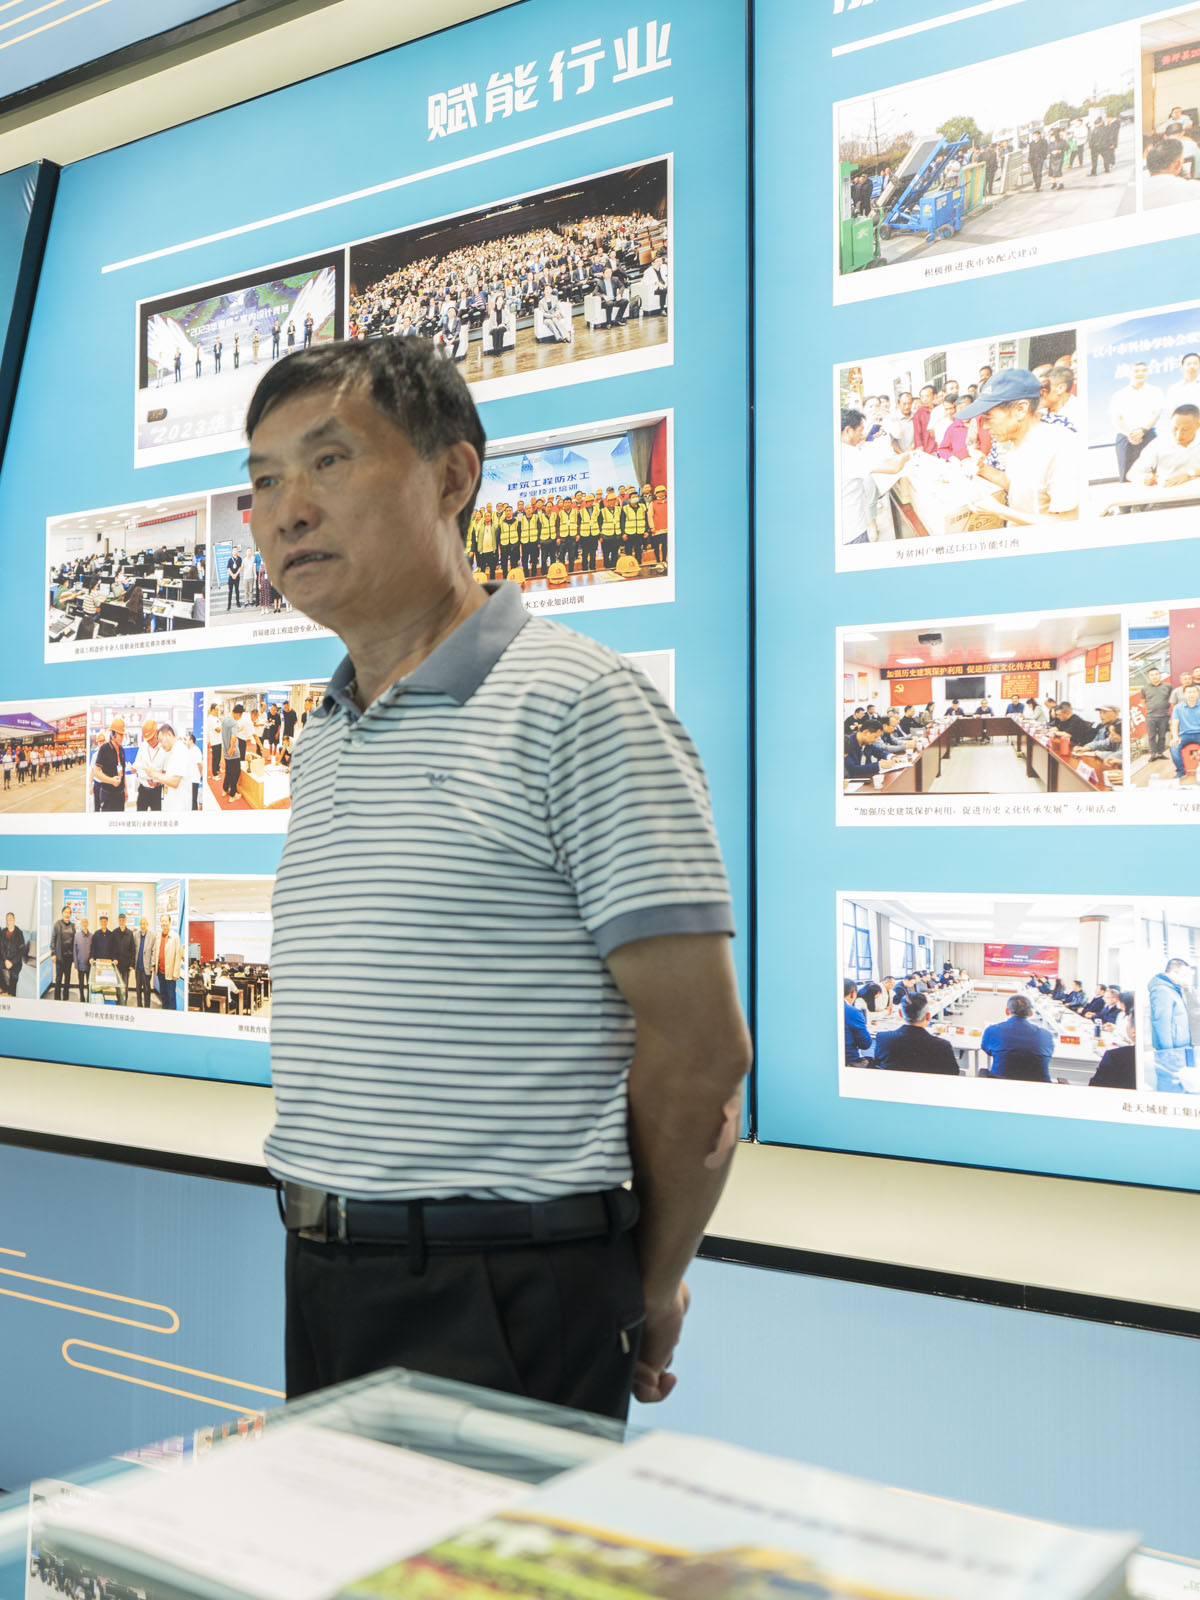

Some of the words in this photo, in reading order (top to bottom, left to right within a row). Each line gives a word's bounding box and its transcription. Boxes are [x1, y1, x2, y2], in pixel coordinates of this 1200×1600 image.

[427, 20, 672, 142] 赋能行业
[507, 471, 590, 491] 建筑工程防水工
[886, 667, 964, 678] 加强历史建筑保护利用
[967, 660, 1051, 674] 促进历史文化传承发展
